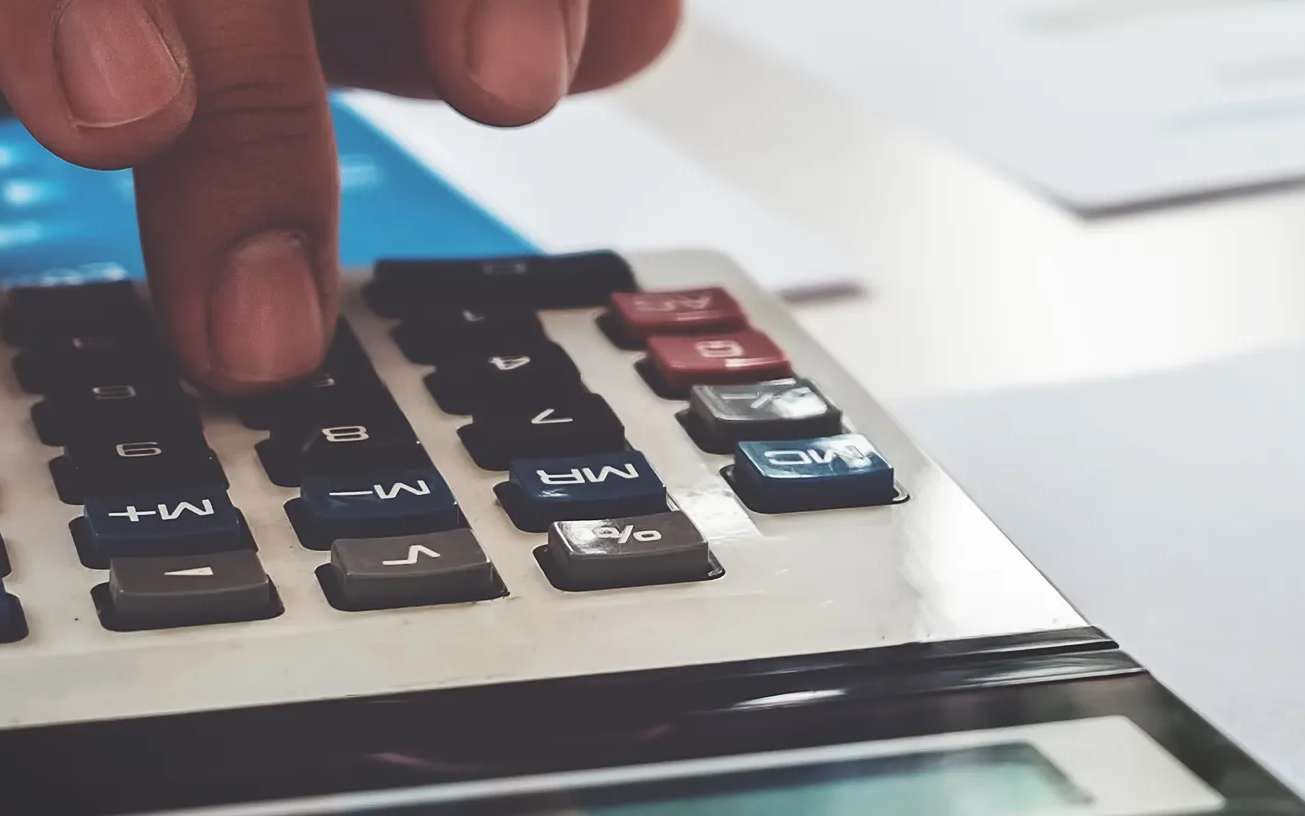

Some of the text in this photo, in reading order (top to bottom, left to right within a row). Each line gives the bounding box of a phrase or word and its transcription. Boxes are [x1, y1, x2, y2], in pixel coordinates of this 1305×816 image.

[487, 355, 532, 371] 4
[530, 407, 574, 425] 7
[321, 424, 371, 443] 8
[115, 441, 162, 458] 9
[763, 444, 869, 469] MC
[536, 462, 641, 486] MR
[107, 497, 214, 524] M+
[591, 524, 662, 545] %
